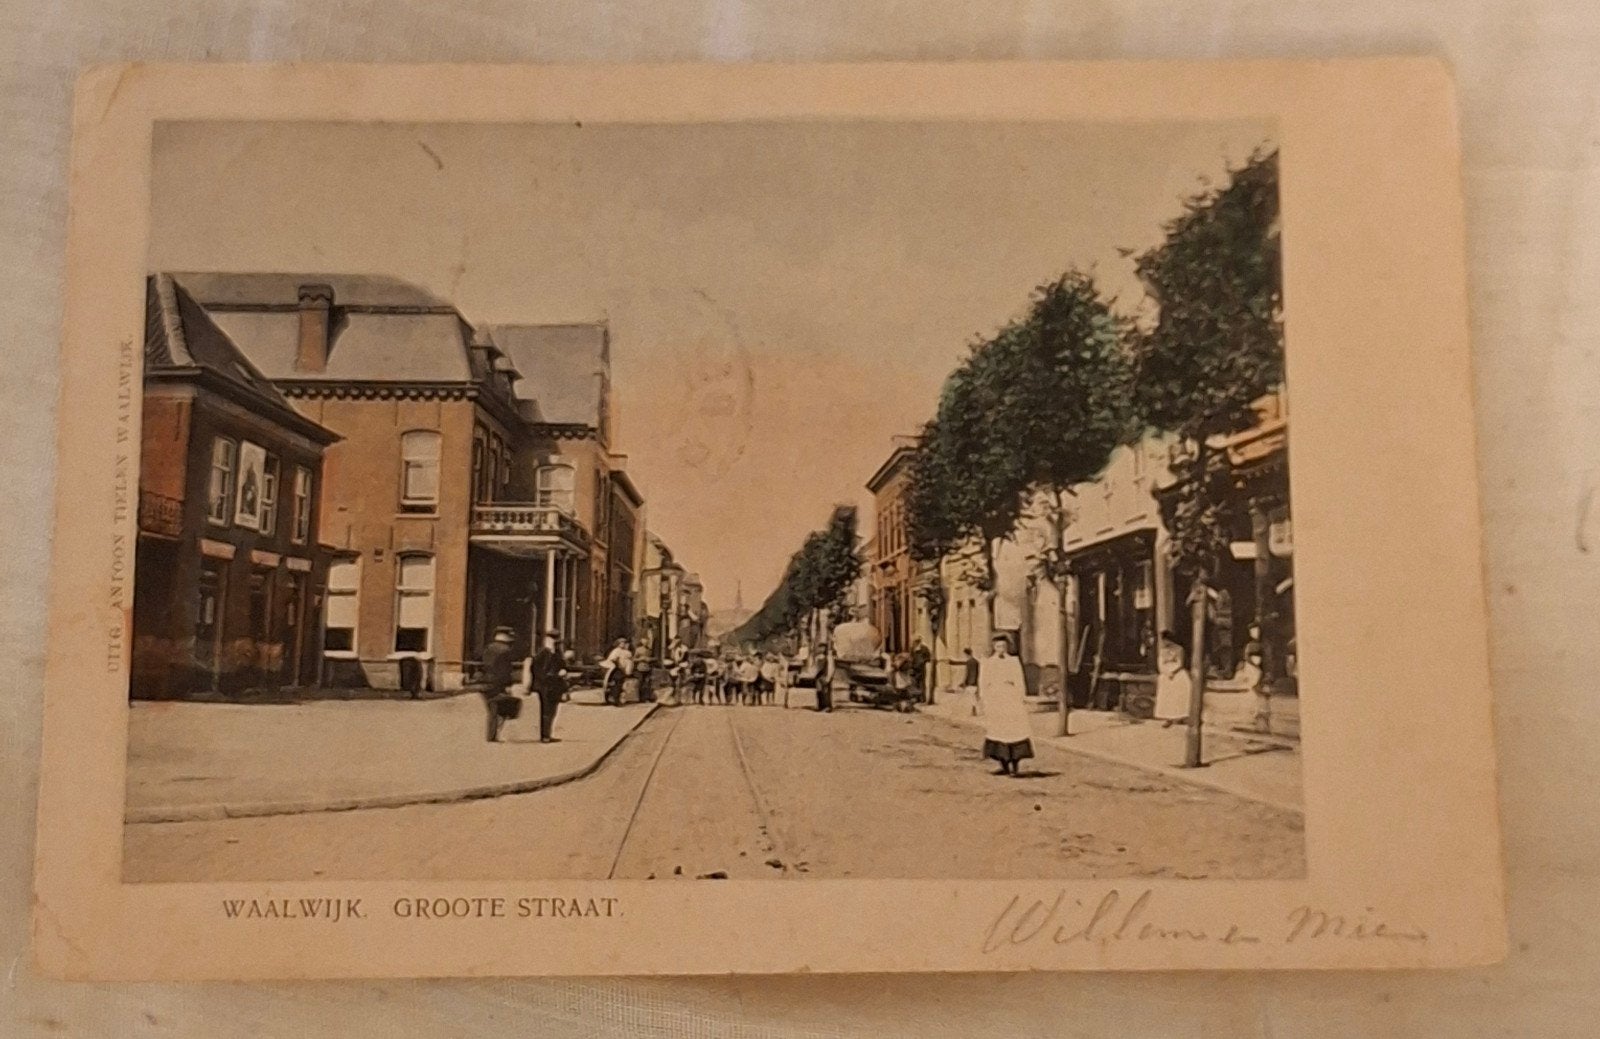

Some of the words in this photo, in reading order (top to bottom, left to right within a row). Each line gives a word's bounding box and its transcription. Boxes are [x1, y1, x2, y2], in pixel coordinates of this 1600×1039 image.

[109, 534, 126, 611] ANTOON
[222, 898, 368, 923] WAALWIJK.
[394, 897, 506, 918] GROOTE
[517, 897, 624, 918] STRAAT.
